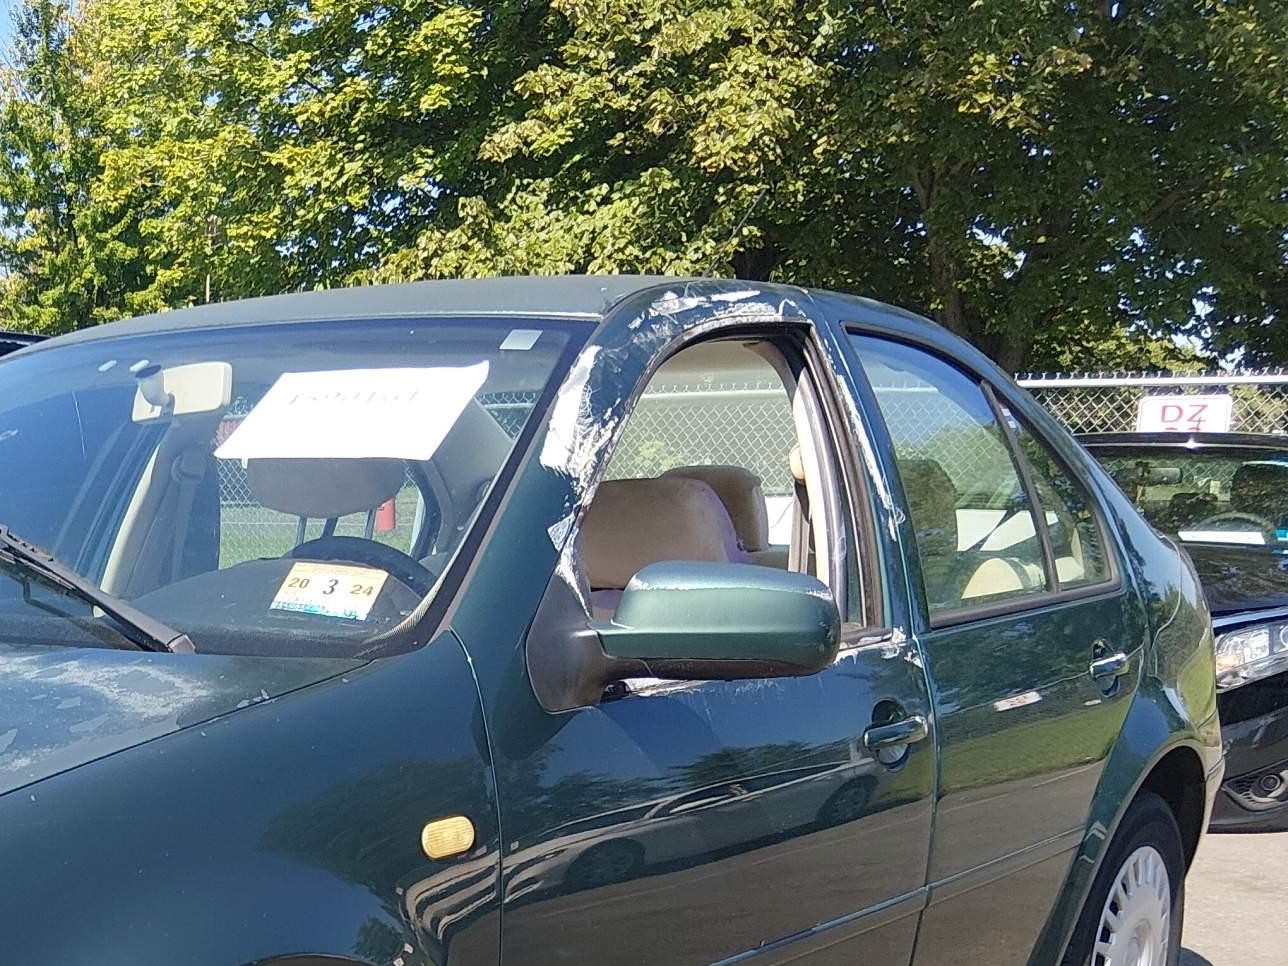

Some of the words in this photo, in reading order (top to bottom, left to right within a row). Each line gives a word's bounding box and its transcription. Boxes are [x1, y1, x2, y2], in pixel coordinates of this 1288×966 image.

[288, 577, 310, 589] 20
[322, 579, 339, 595] 3
[349, 584, 374, 596] 24
